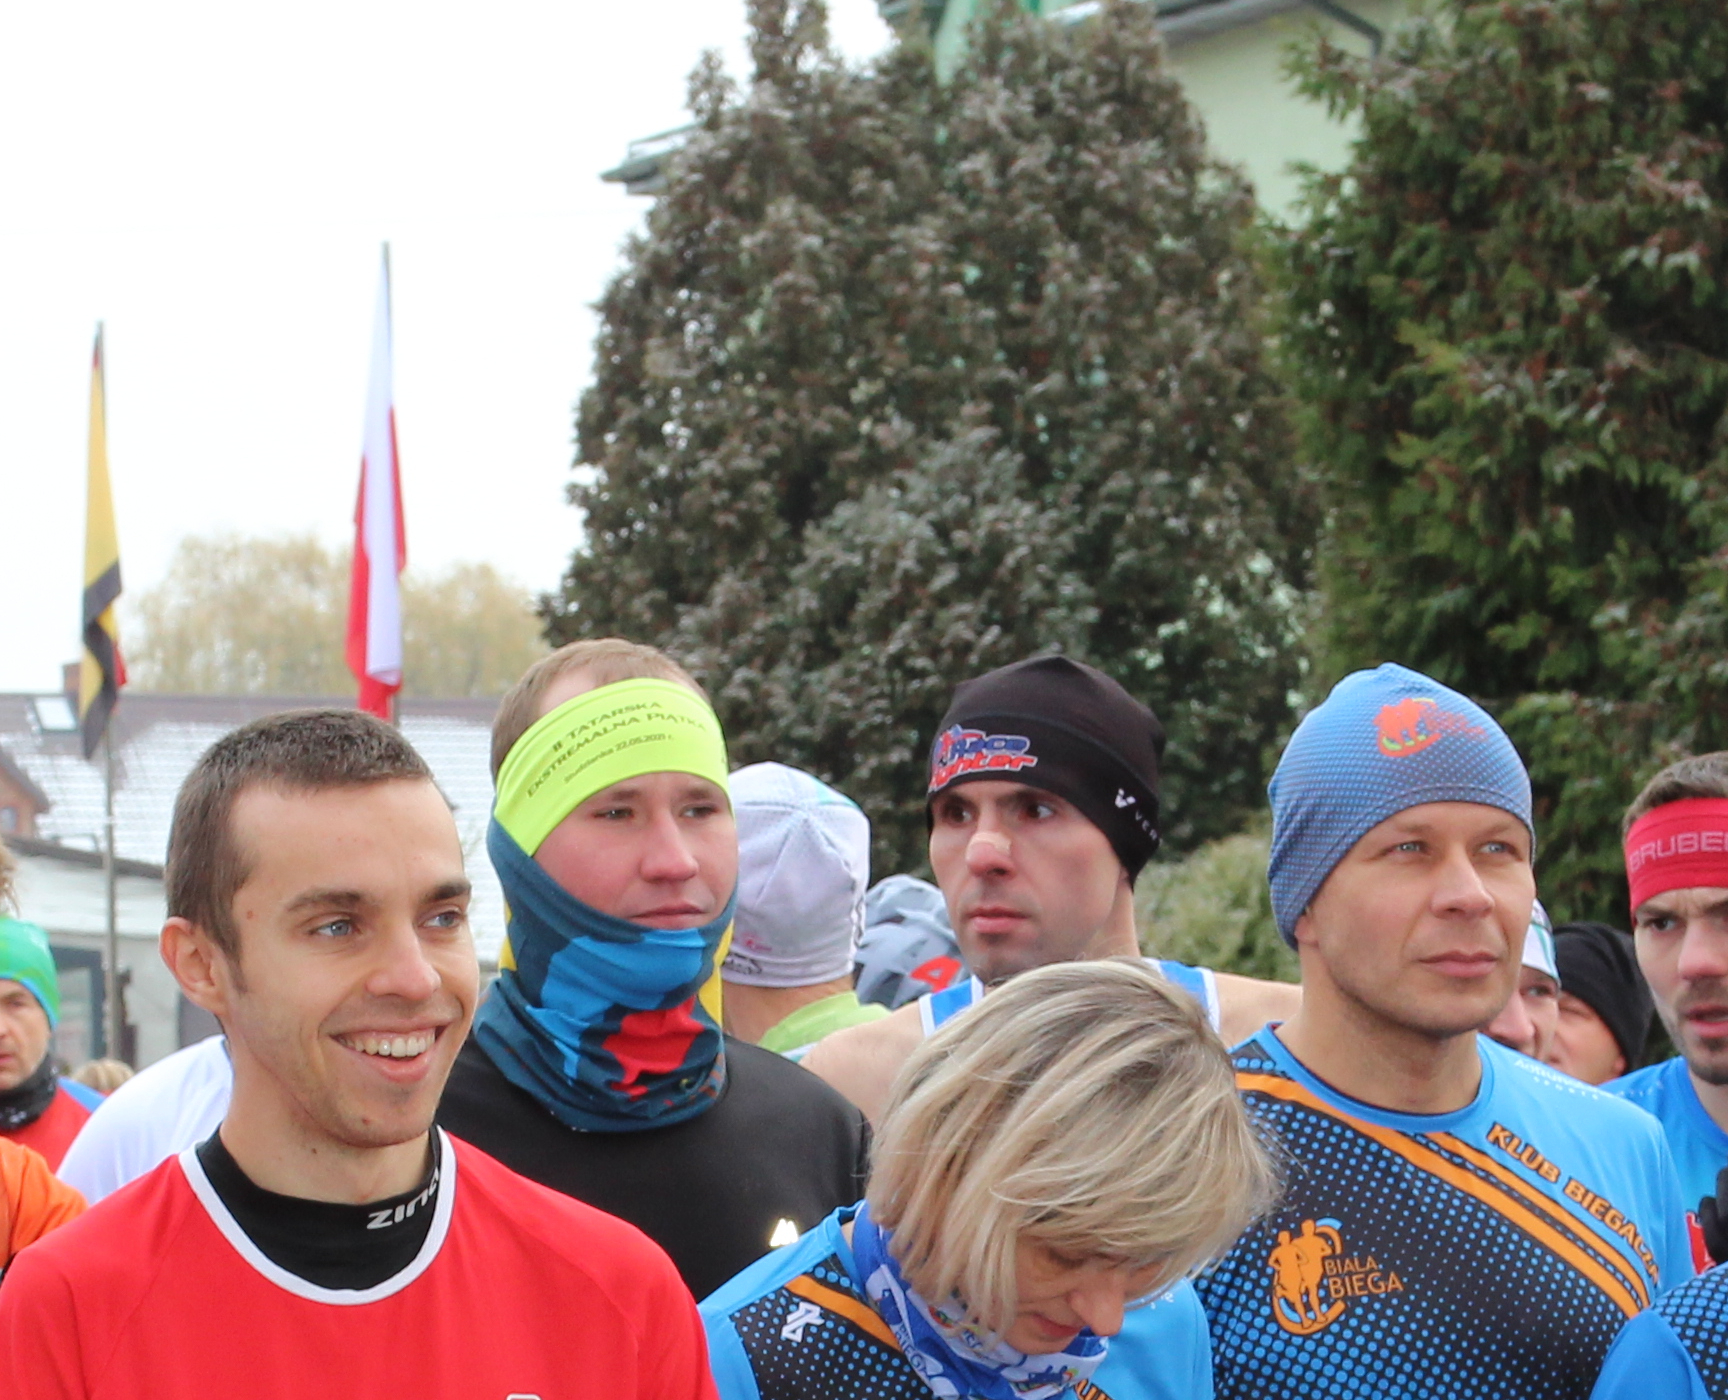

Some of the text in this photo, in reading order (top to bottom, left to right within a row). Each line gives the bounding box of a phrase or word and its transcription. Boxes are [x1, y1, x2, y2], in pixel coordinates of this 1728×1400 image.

[566, 702, 662, 739] TATARSKA
[527, 717, 640, 798] EKSTREMALNA
[1486, 1122, 1561, 1183] KLUB
[1328, 1271, 1404, 1299] BIEGA
